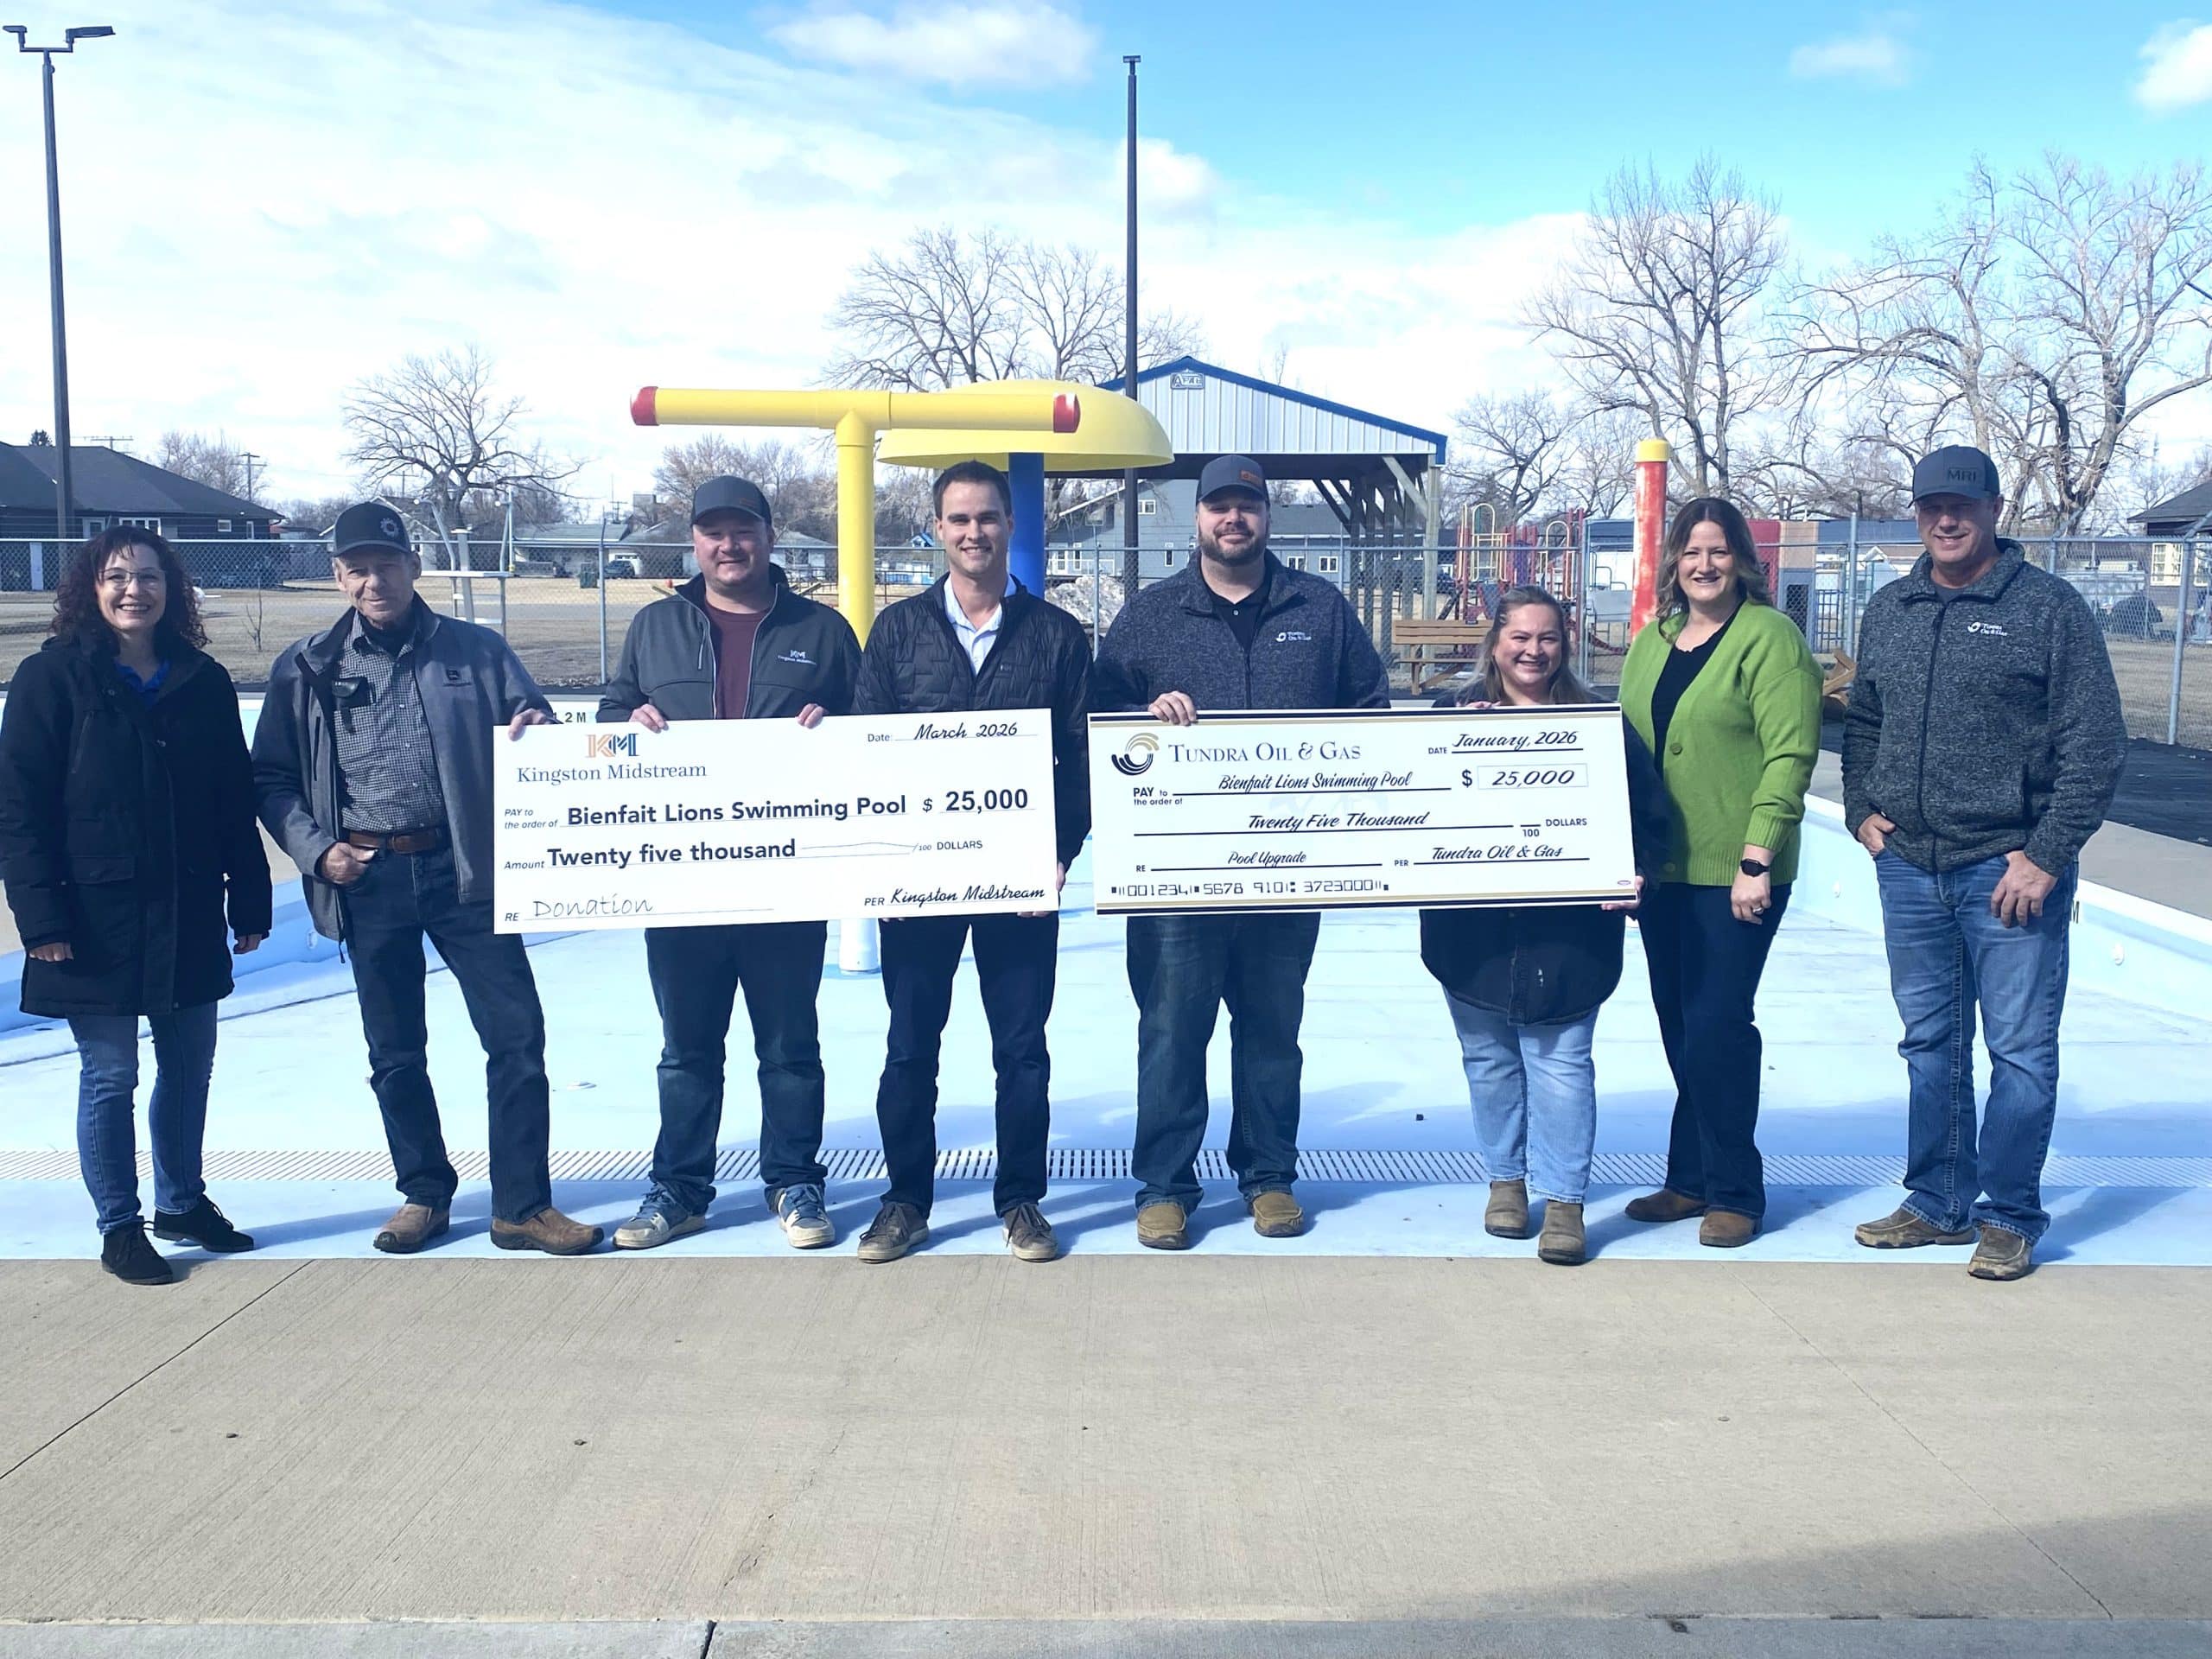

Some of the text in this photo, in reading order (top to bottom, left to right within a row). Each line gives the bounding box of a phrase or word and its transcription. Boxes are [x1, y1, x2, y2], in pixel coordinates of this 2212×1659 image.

[913, 722, 967, 741] March
[976, 721, 1018, 738] 2026
[1452, 733, 1531, 751] January,
[1535, 731, 1578, 745] 2026
[1168, 741, 1361, 763] TUNDRA OIL & GAS
[517, 763, 707, 786] Kingston Midstream
[1133, 787, 1154, 798] PAY
[1218, 774, 1272, 793] Bienfait
[1275, 773, 1309, 789] Lions
[1313, 772, 1378, 791] Swimming
[1380, 772, 1413, 787] Pool
[1462, 769, 1575, 788] $ 25,000
[505, 808, 522, 817] PAY
[568, 789, 1028, 825] Bienfait Lions Swimming Pool $ 25,000
[505, 819, 558, 830] the order of
[1249, 811, 1587, 832] Twenty Five Thousand DOLLARS
[1522, 829, 1540, 837] 100
[505, 861, 544, 869] Amount
[547, 847, 632, 869] Twenty
[639, 844, 682, 863] five
[690, 838, 795, 860] thousand
[937, 840, 983, 850] DOLLARS
[1228, 851, 1257, 865] Pool
[1258, 851, 1306, 868] Upgrade
[1432, 847, 1483, 860] Tundra
[1487, 845, 1516, 859] Oil
[1516, 847, 1531, 858] &
[1535, 844, 1563, 858] Gas
[864, 884, 1045, 907] PER Kingston Midstream
[505, 893, 653, 922] RE Donation
